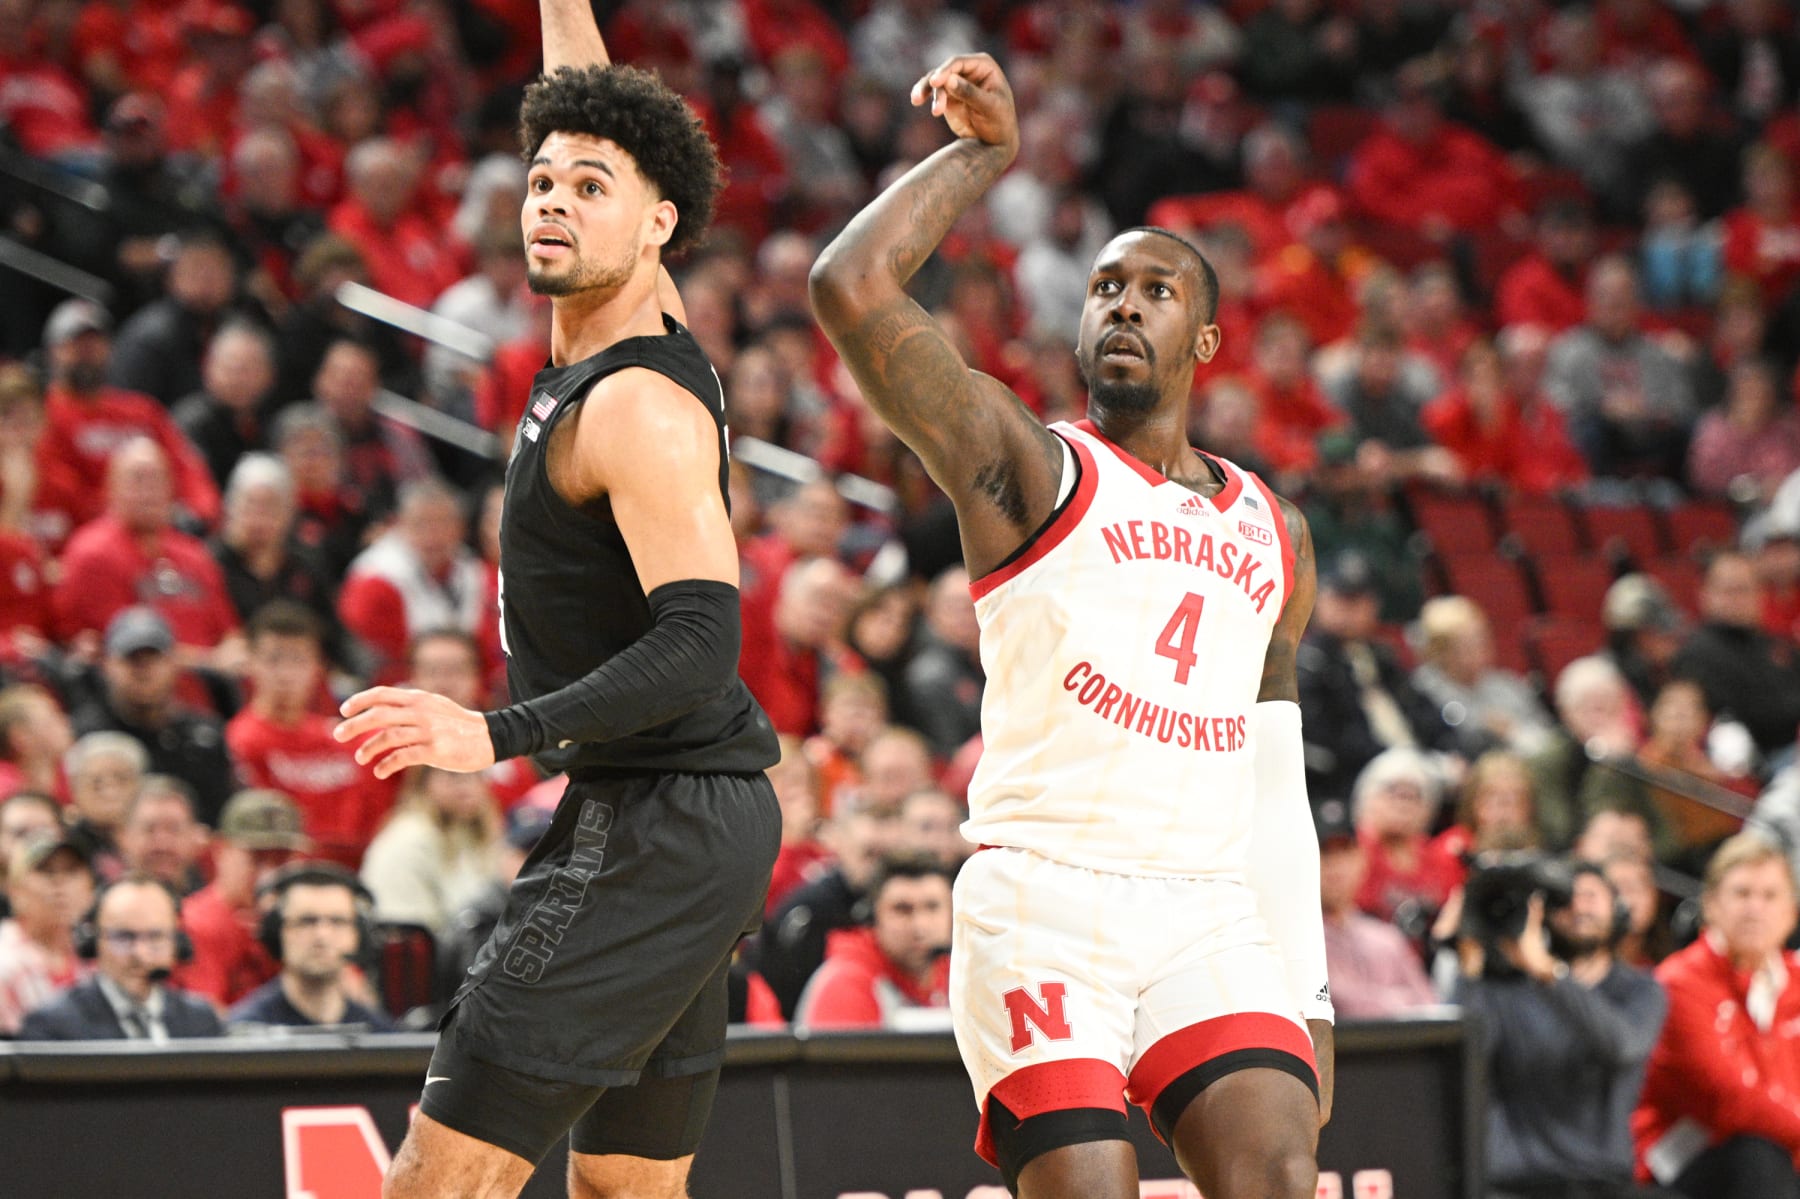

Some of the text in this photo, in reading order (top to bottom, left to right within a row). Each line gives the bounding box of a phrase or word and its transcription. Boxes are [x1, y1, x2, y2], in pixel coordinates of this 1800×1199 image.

[1176, 505, 1210, 518] adidas
[1100, 520, 1276, 615] NEBRASKA
[1154, 591, 1205, 686] 4
[1063, 661, 1246, 753] CORNHUSKERS
[503, 799, 615, 985] SPARTANS
[1001, 981, 1074, 1056] N
